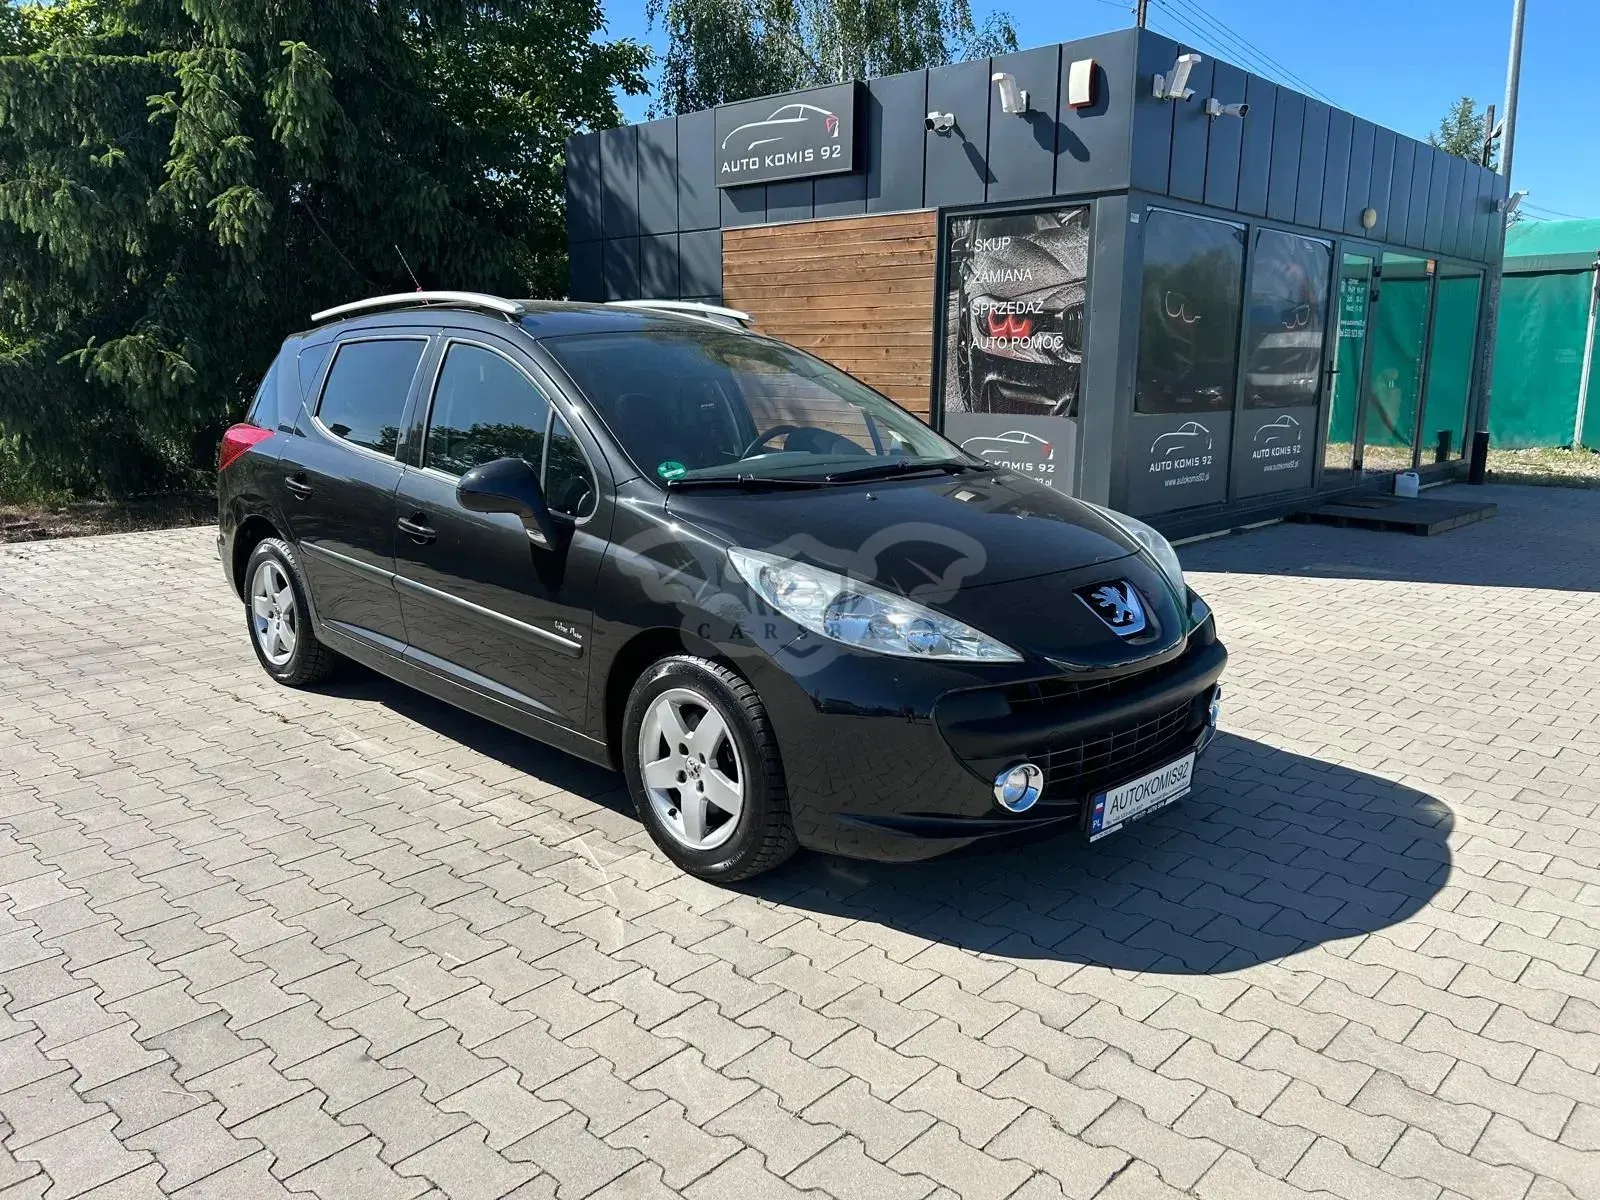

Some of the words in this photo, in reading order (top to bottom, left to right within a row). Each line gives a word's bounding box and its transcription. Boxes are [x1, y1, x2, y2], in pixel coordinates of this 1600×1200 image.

[721, 157, 759, 173] AUTO
[765, 149, 814, 167] KOMIS
[821, 145, 841, 159] 92
[974, 237, 1011, 251] SKUP
[973, 268, 1033, 283] ZAMIANA
[972, 298, 1044, 315] SPRZEDAŻ
[971, 337, 1008, 349] AUTO
[1011, 336, 1064, 349] POMOC
[1252, 450, 1270, 459] AUTO
[1271, 446, 1291, 456] KOMIS
[1038, 463, 1055, 473] 92
[1149, 461, 1172, 473] AUTO
[1174, 457, 1200, 469] KOMIS
[1202, 455, 1212, 465] 92
[1109, 761, 1189, 815] AUTOKOMIS92
